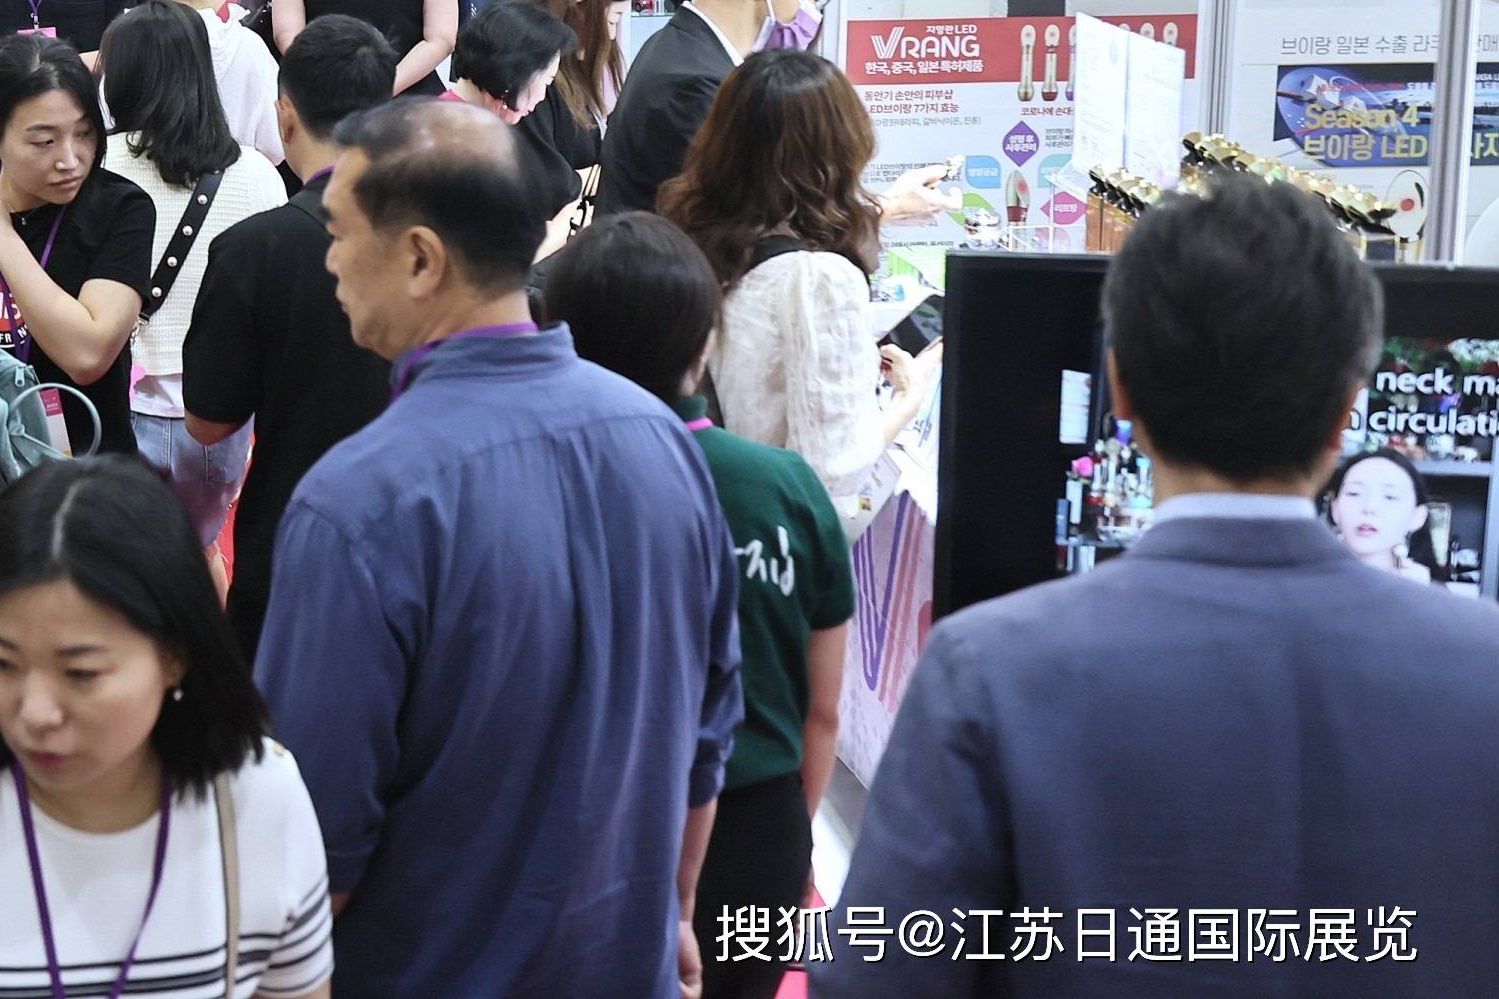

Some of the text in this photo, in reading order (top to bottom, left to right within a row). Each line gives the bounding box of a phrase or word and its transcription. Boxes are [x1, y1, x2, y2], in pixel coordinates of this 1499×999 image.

[955, 24, 977, 34] LED
[871, 26, 980, 59] VRANG
[1281, 35, 1410, 55] 브이랑 일본 수출
[1304, 104, 1420, 130] Season 4
[1304, 134, 1428, 160] 브이랑 LED
[1376, 366, 1454, 396] neck
